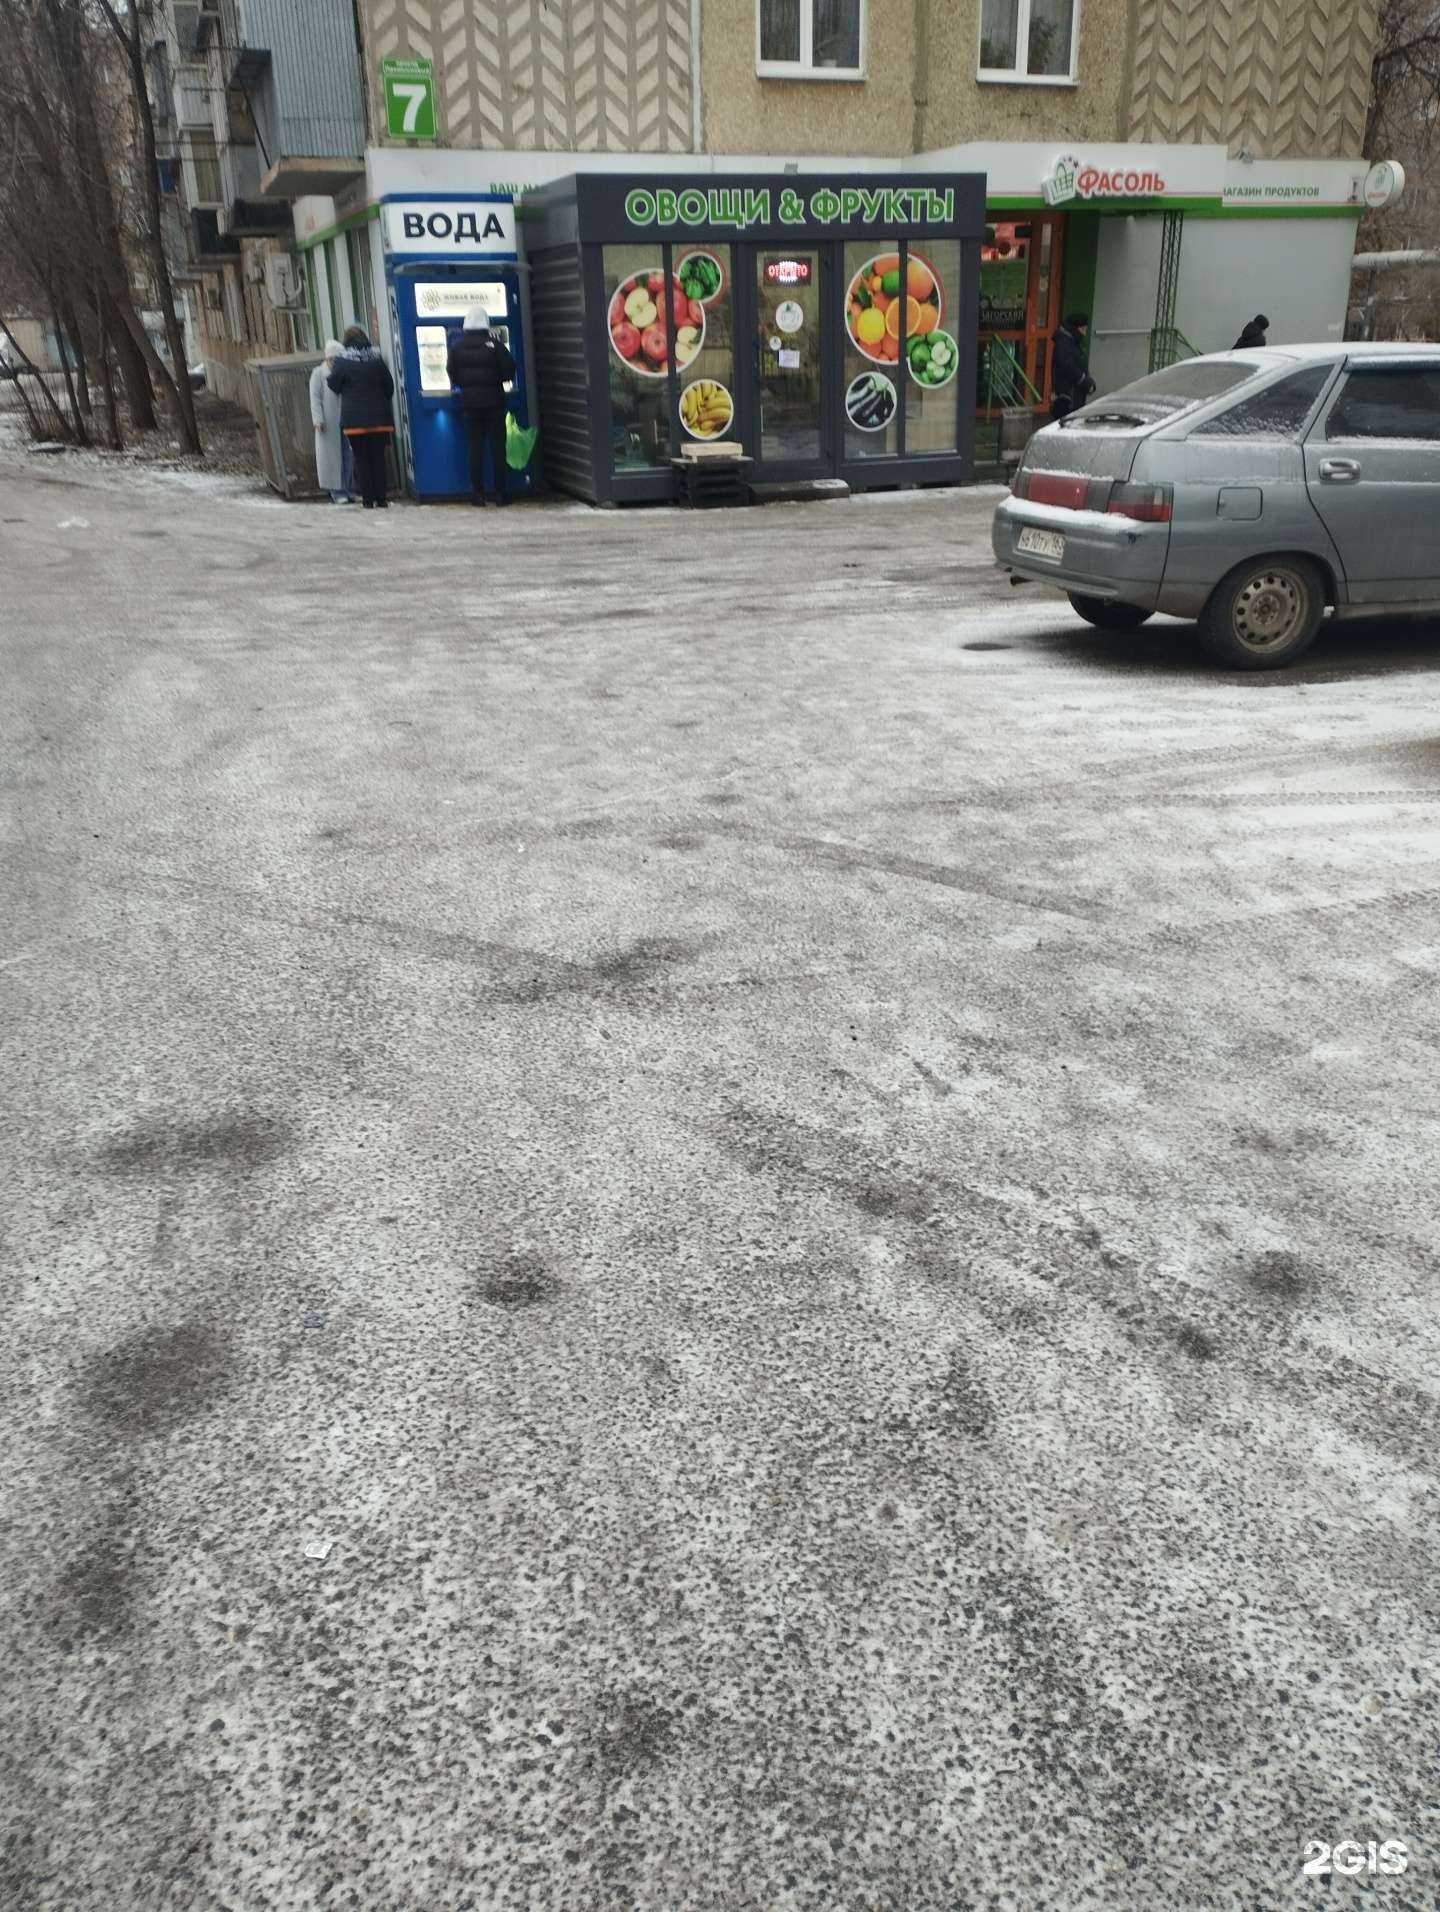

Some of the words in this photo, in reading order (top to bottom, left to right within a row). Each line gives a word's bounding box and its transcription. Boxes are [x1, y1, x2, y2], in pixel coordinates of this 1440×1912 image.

[392, 83, 427, 132] 7
[625, 188, 770, 229] ОВОЩИ
[778, 188, 804, 224] &
[811, 187, 954, 224] ФРУКТЫ
[1265, 187, 1319, 197] ПРОДУКТОВ
[403, 212, 506, 244] ВОДА
[768, 264, 808, 277] ОТКРЫТО
